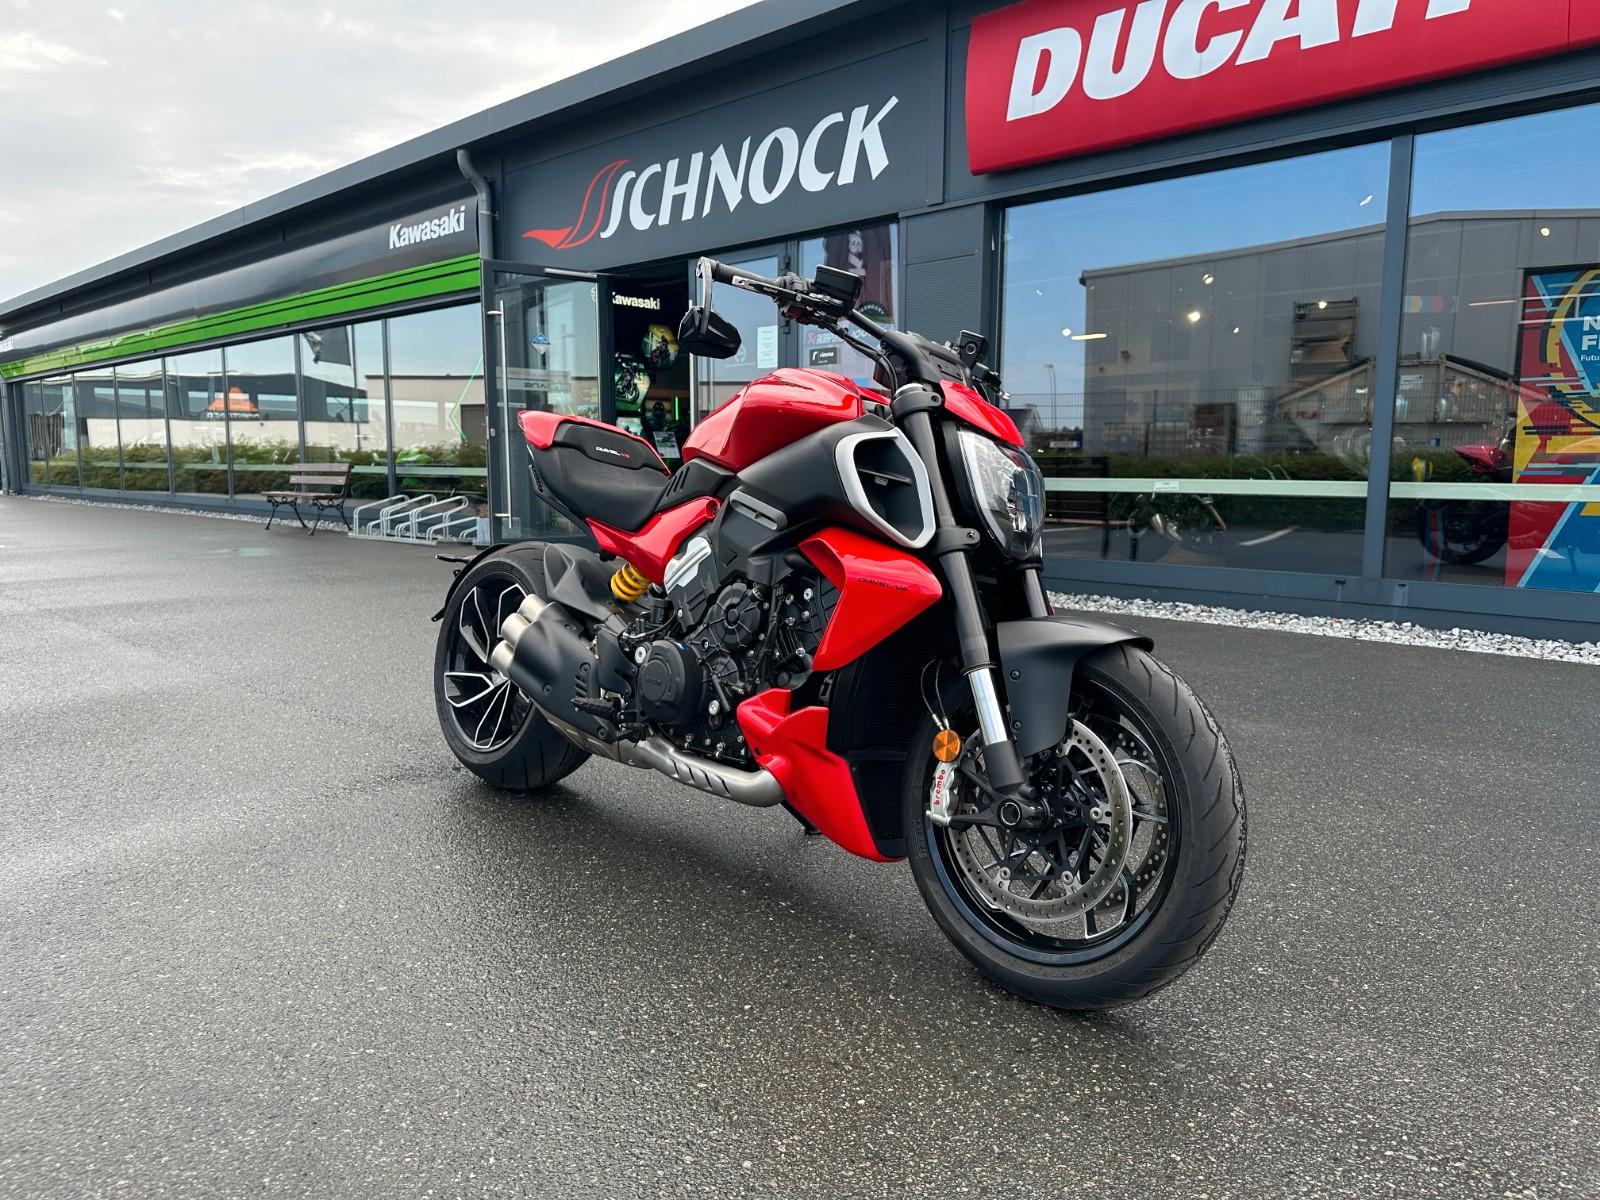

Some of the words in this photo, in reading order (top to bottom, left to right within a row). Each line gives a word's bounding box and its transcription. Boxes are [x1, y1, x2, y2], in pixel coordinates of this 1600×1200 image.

[1006, 0, 1472, 122] DUCA
[600, 95, 899, 238] SCHNOCK
[389, 205, 466, 249] Kawasaki
[933, 769, 946, 805] brembo
